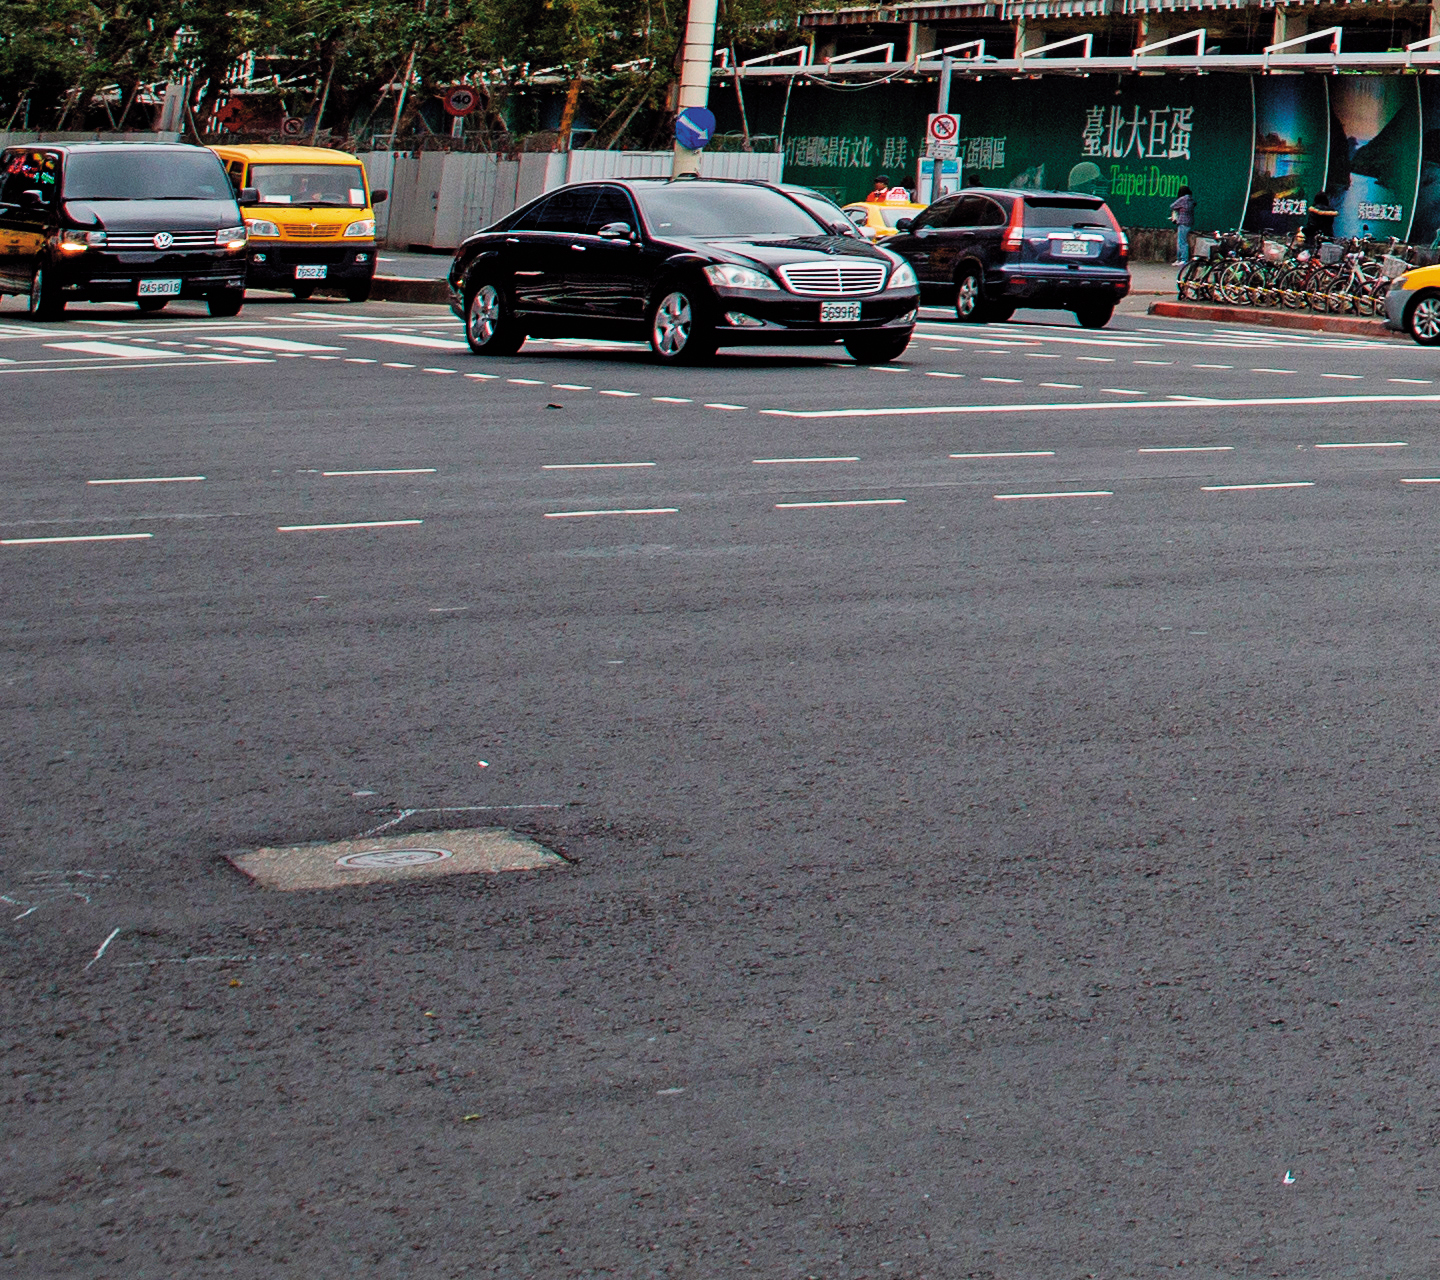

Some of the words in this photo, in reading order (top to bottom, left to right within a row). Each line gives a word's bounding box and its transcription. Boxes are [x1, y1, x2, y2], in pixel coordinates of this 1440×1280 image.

[452, 94, 471, 105] 40
[1081, 105, 1194, 160] 臺北大巨蛋
[1110, 165, 1147, 205] Taipei
